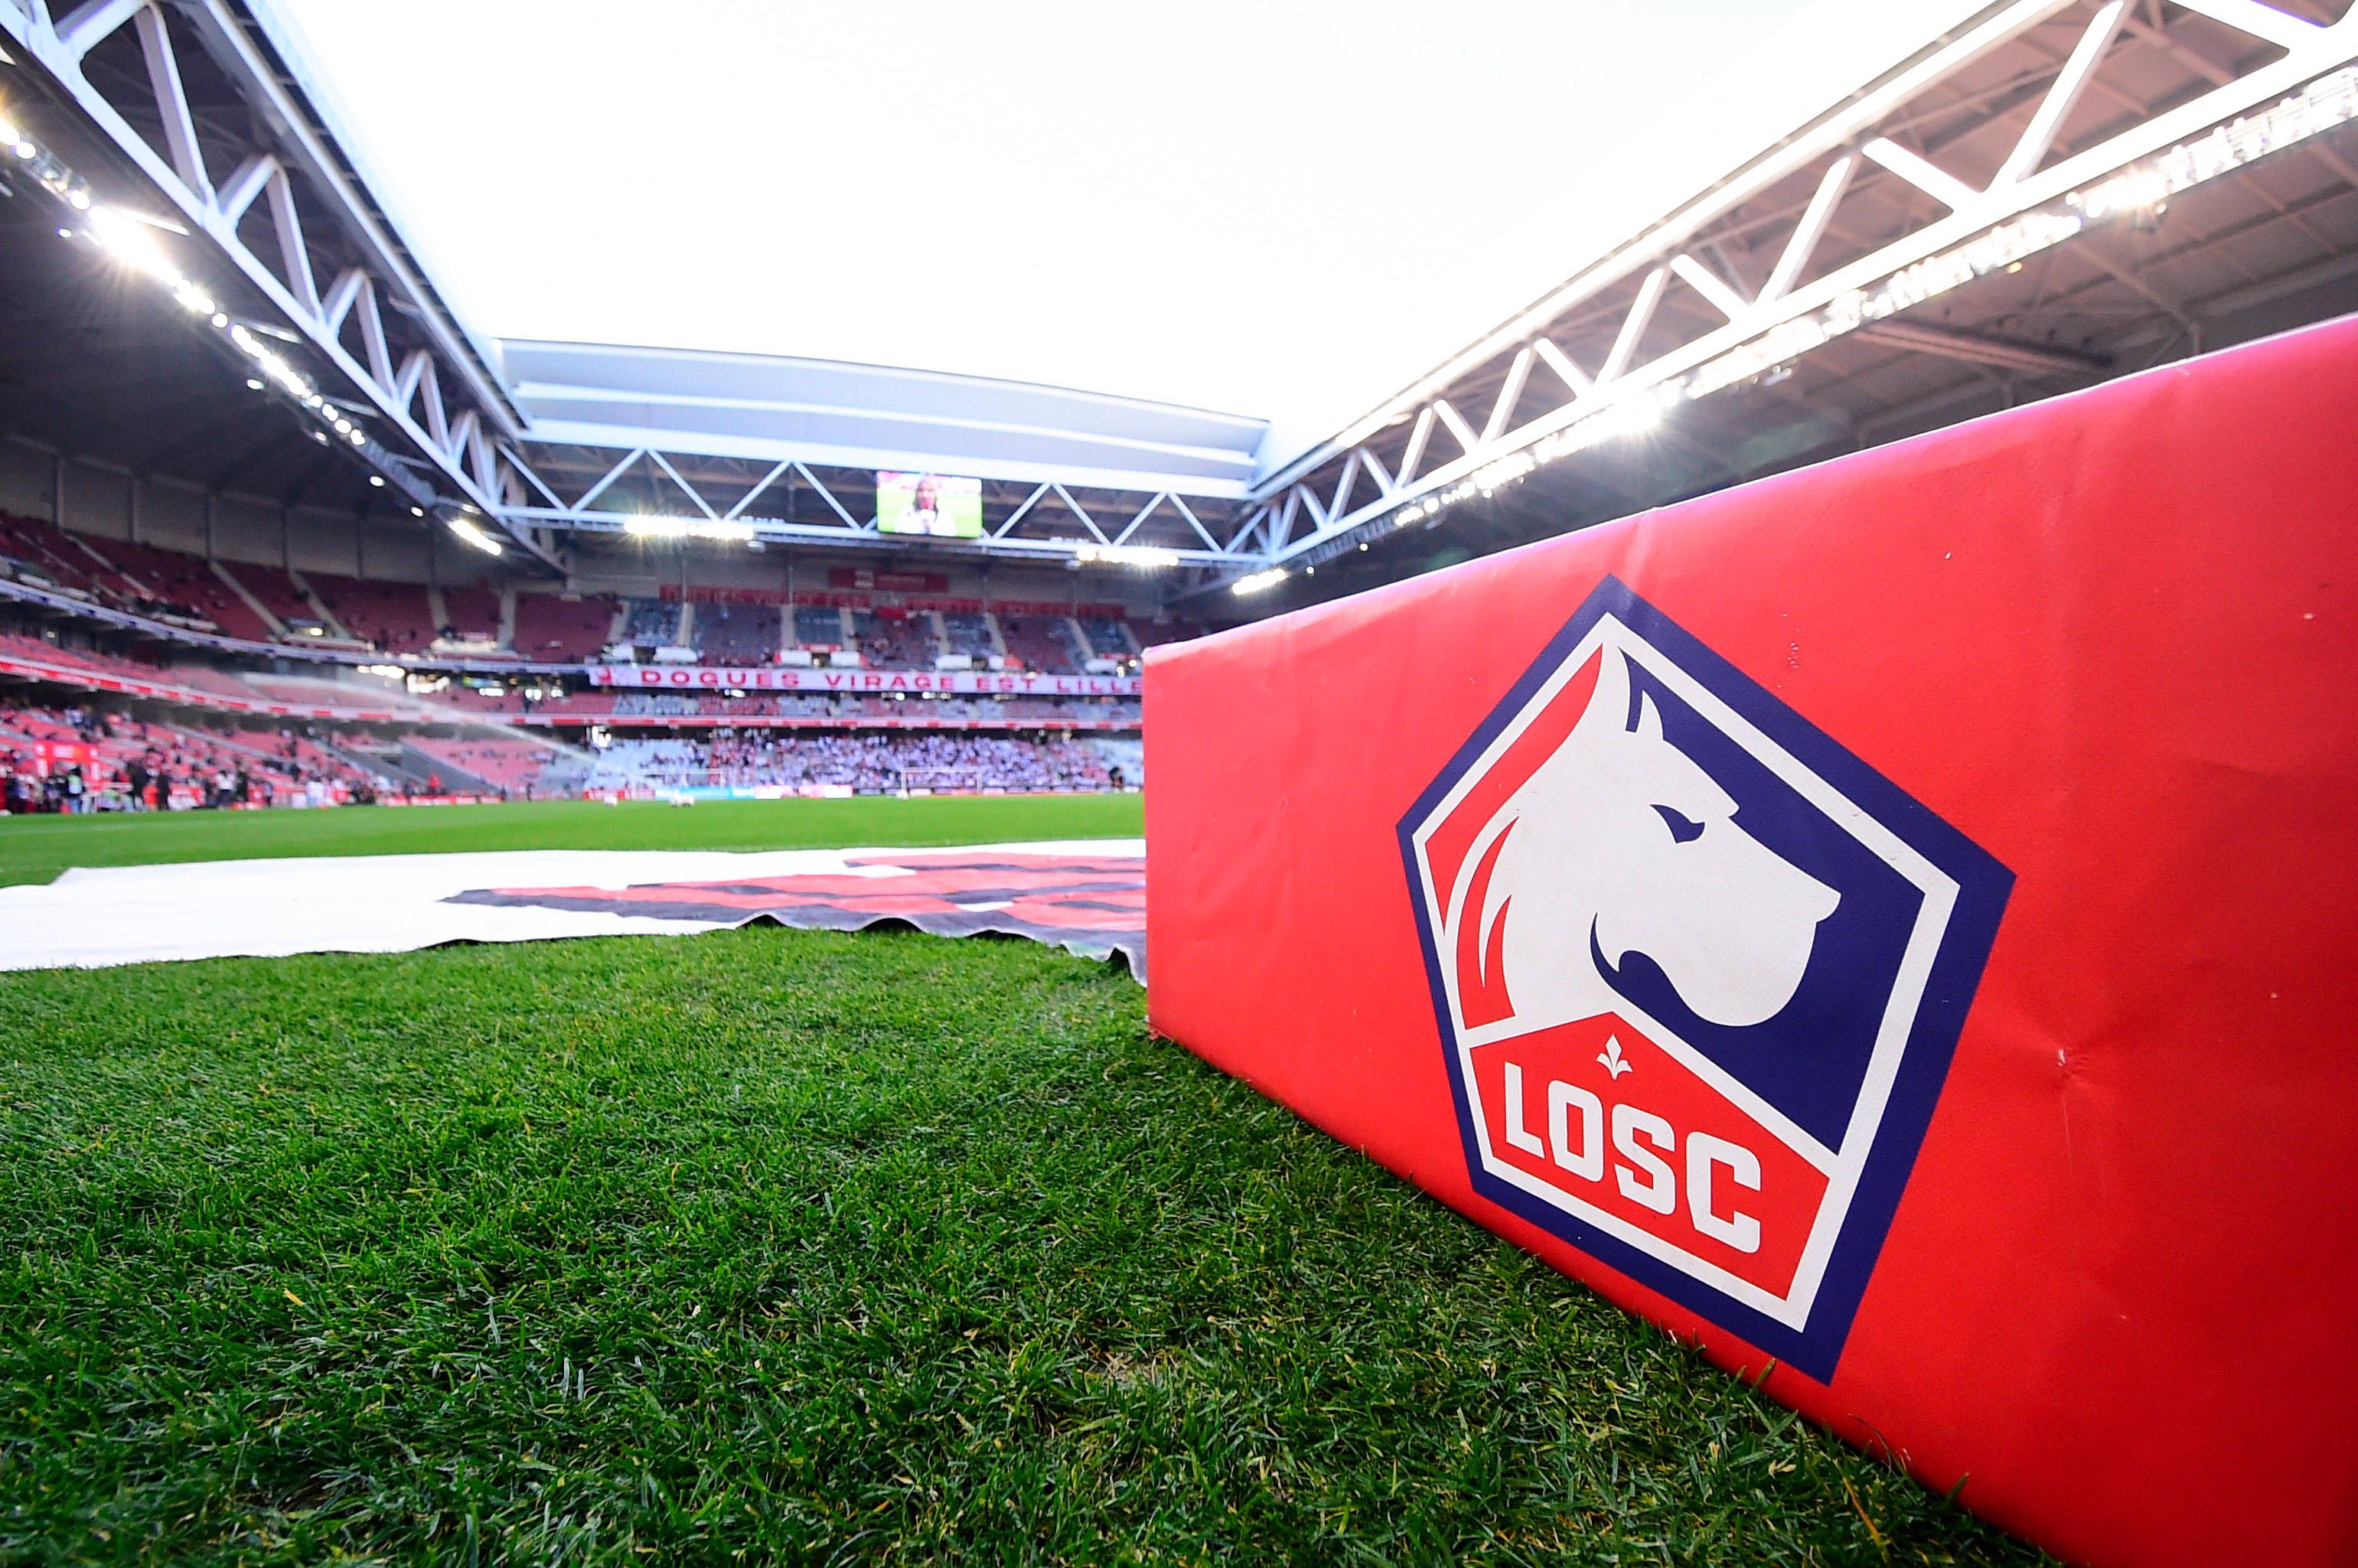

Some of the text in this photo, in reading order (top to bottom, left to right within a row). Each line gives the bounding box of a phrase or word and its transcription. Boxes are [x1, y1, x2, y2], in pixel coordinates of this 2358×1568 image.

[641, 670, 1142, 693] DOGUES VIRAGE EST LILLE
[1505, 1061, 1761, 1253] LOSC
